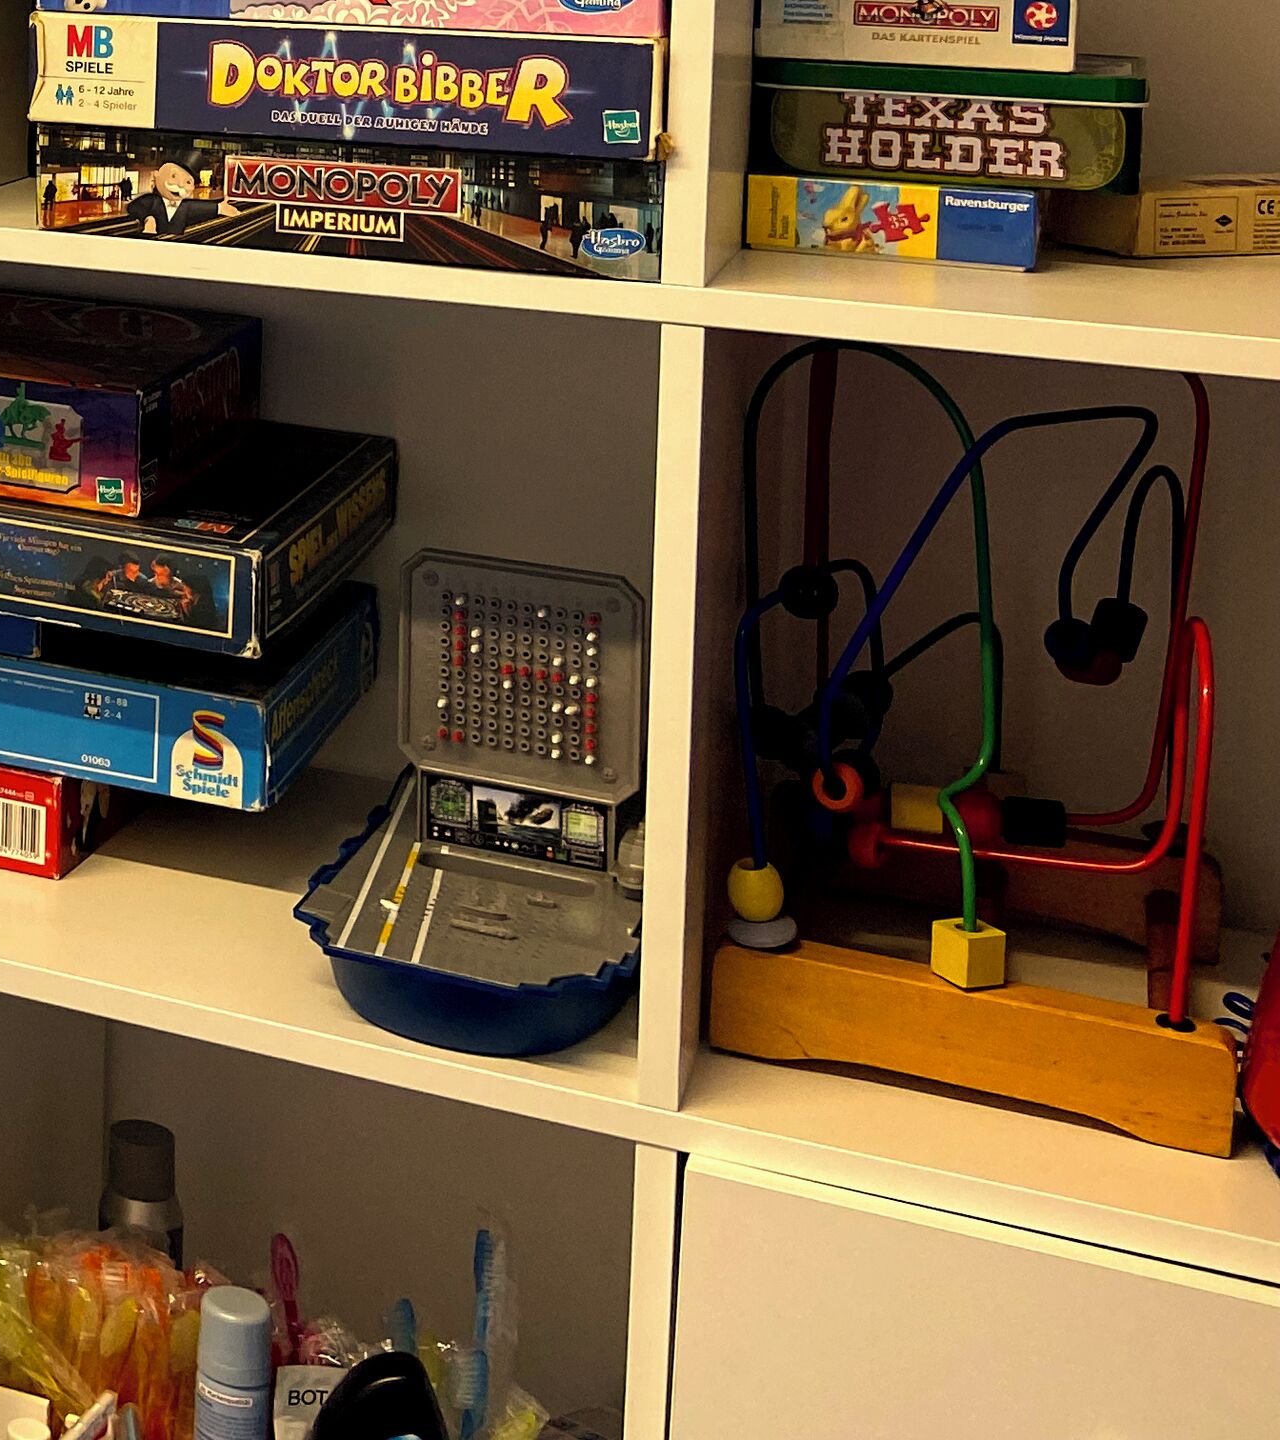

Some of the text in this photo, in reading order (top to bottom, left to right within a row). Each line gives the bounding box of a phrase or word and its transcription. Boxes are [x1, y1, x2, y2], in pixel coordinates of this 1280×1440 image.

[66, 24, 113, 58] MB
[871, 31, 981, 45] DAS KARTENSPIEL
[65, 61, 113, 74] SPIELE
[209, 41, 387, 106] DOKTOR
[843, 90, 1045, 135] TEXAS
[823, 126, 1065, 178] HOLDER
[231, 162, 454, 207] MONOPOLY
[945, 196, 1030, 213] Ravensburger
[282, 208, 397, 235] IMPERIUM
[888, 211, 909, 231] 35
[81, 753, 111, 769] 01063
[175, 763, 239, 789] Schmidt
[182, 779, 230, 799] Spiele
